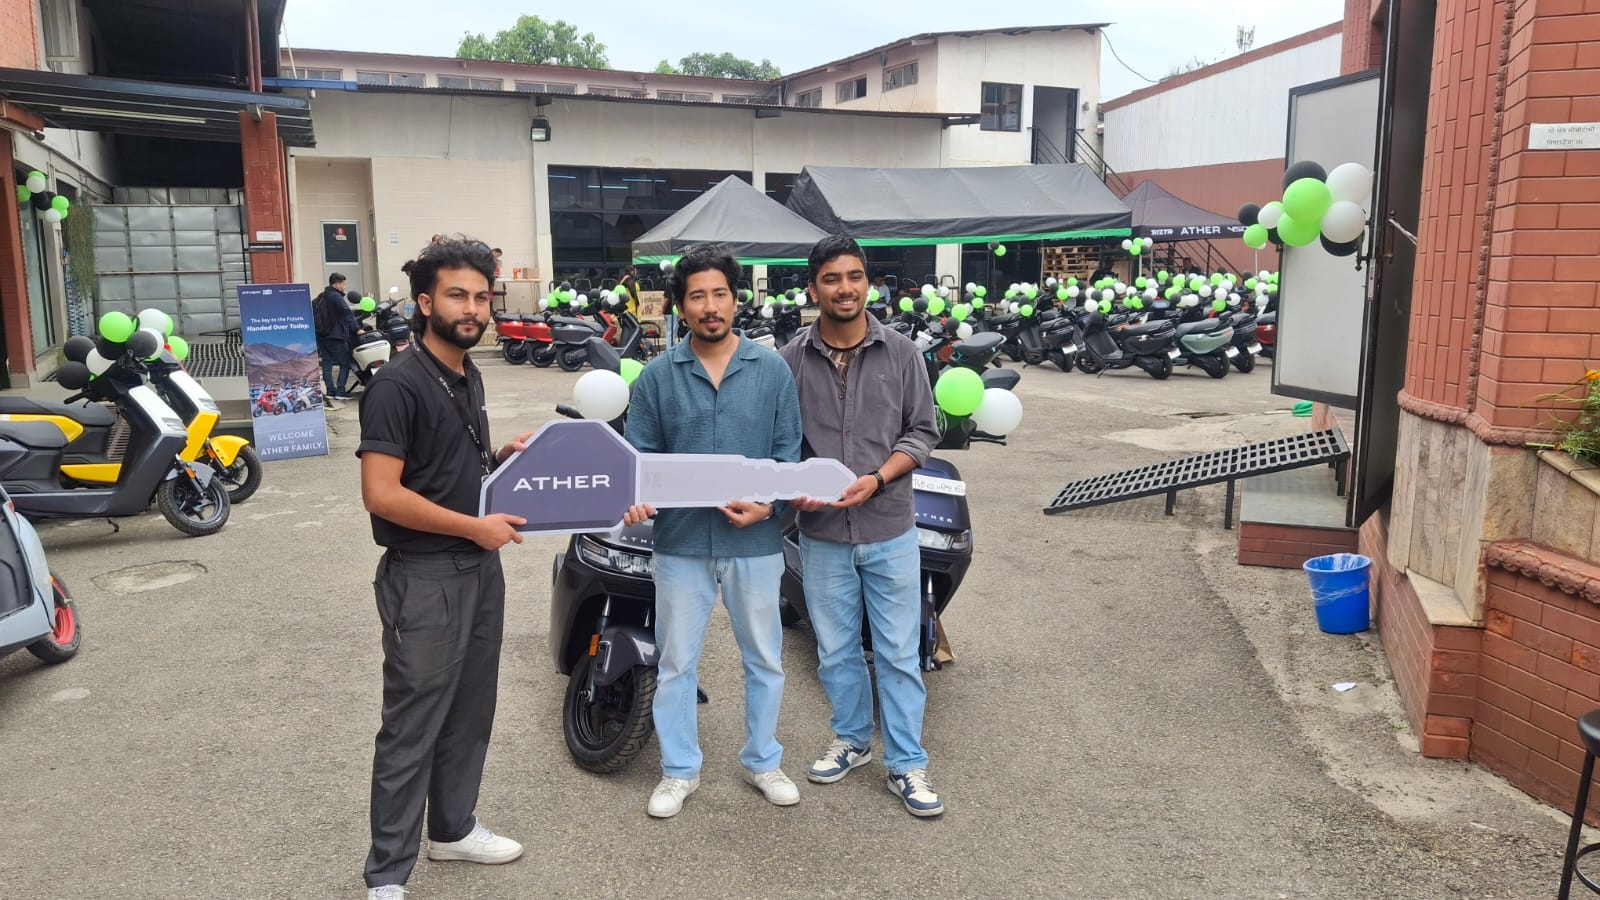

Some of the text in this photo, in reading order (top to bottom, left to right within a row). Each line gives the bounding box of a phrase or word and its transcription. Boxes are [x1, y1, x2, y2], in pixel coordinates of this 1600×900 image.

[1180, 226, 1221, 235] ATHER
[268, 430, 314, 441] WELCOME
[261, 441, 325, 456] ATHER FAMILY.
[512, 474, 611, 492] ATHER
[914, 512, 953, 523] ATHER
[620, 535, 654, 545] ATH
